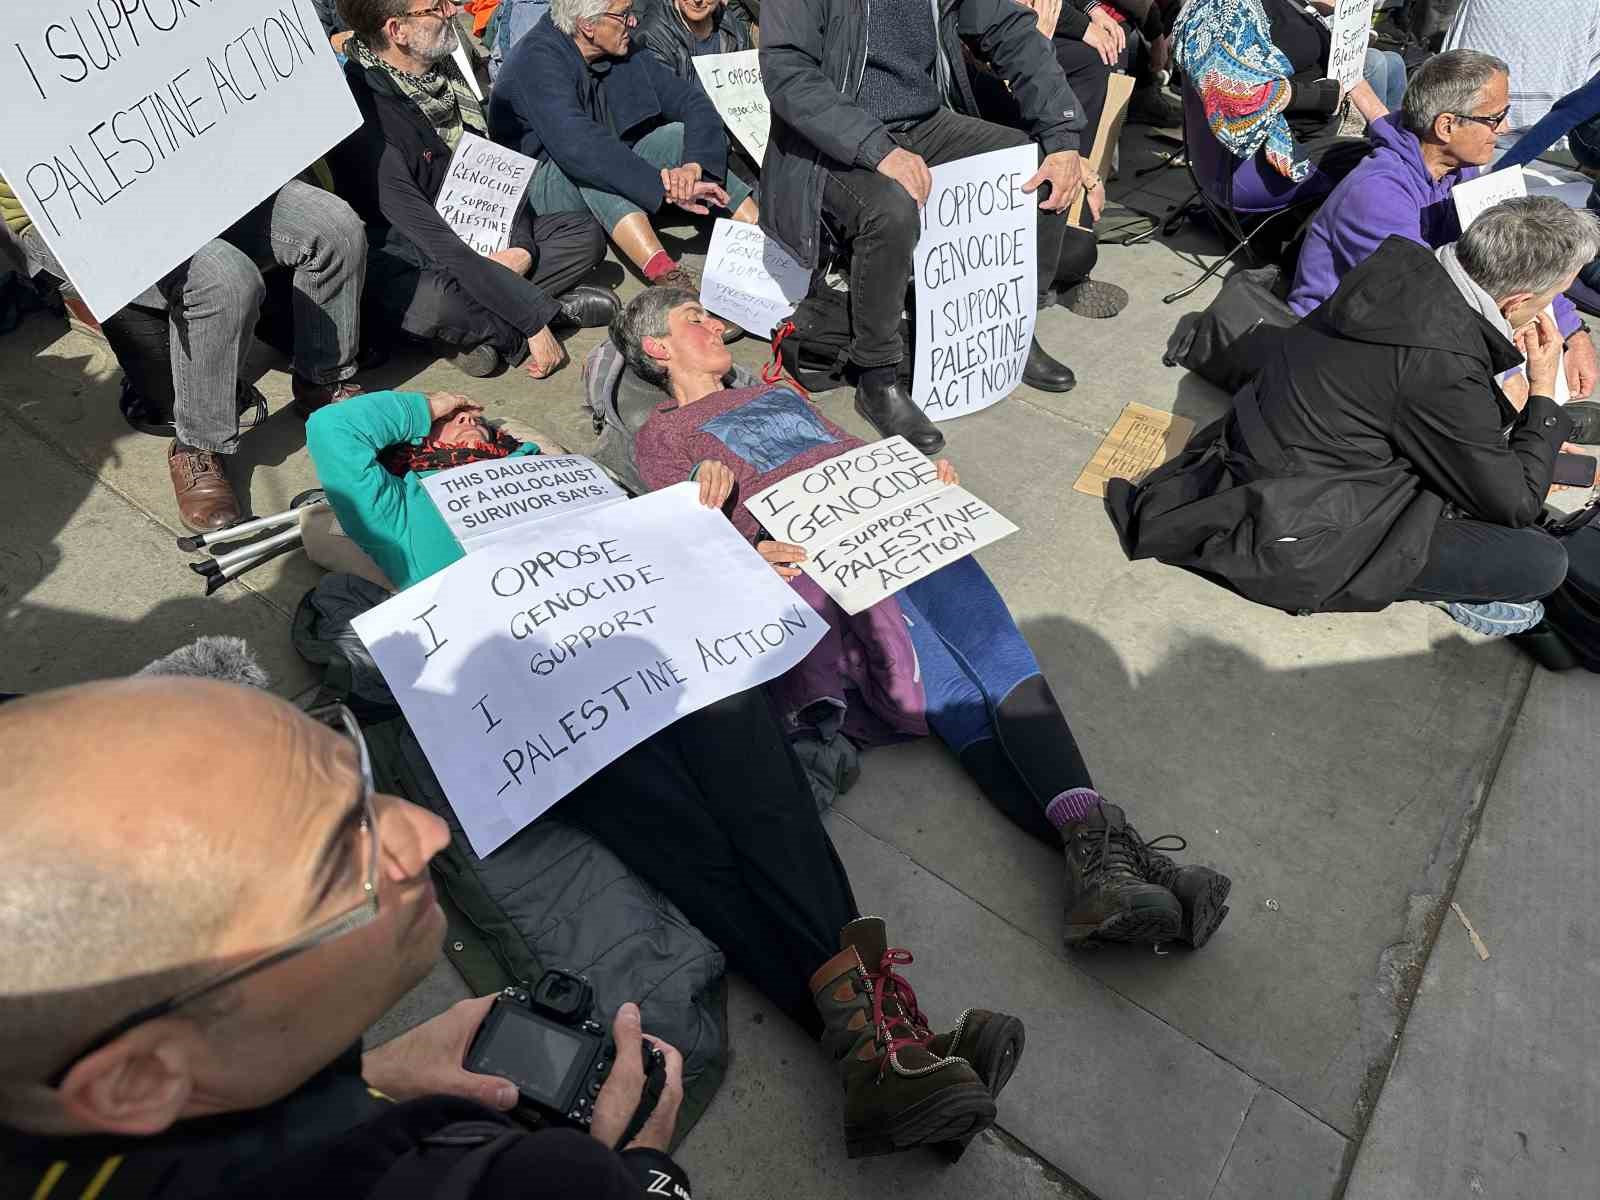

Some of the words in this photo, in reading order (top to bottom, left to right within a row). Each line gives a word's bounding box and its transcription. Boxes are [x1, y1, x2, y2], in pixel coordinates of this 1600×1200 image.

[15, 42, 47, 100] I
[26, 68, 216, 237] PALESTINE
[206, 0, 315, 114] ACTION
[452, 161, 520, 196] GENOCIDE
[462, 143, 473, 158] I
[476, 151, 525, 179] OPPOSE
[441, 205, 508, 233] PALESTINE
[445, 189, 454, 201] I
[461, 195, 509, 219] SUPPORT
[938, 172, 1025, 228] OPPOSE
[924, 228, 1026, 290] GENOCIDE
[930, 309, 935, 343] I
[942, 275, 1024, 337] SUPPORT
[930, 315, 1028, 383] PALESTINE
[923, 370, 976, 414] ACT
[982, 351, 1024, 399] NOW
[440, 472, 484, 494] THIS
[485, 458, 581, 481] DAUGHTER
[447, 494, 474, 513] OF
[477, 489, 493, 505] A
[493, 467, 599, 499] HOLOCAUST
[462, 493, 557, 529] SURVIVOR
[558, 484, 609, 501] SAYS:
[760, 489, 795, 517] I
[802, 442, 919, 494] OPPOSE
[786, 461, 938, 544] GENOCIDE
[812, 549, 837, 573] I
[838, 496, 942, 556] SUPPORT
[834, 501, 990, 588] PALESTINE
[878, 527, 976, 590] ACTION
[412, 604, 448, 659] I
[491, 538, 633, 597] OPPOSE
[510, 564, 665, 641] GENOCIDE
[471, 693, 503, 734] I
[529, 604, 657, 676] SUPPORT
[695, 603, 808, 673] ACTION
